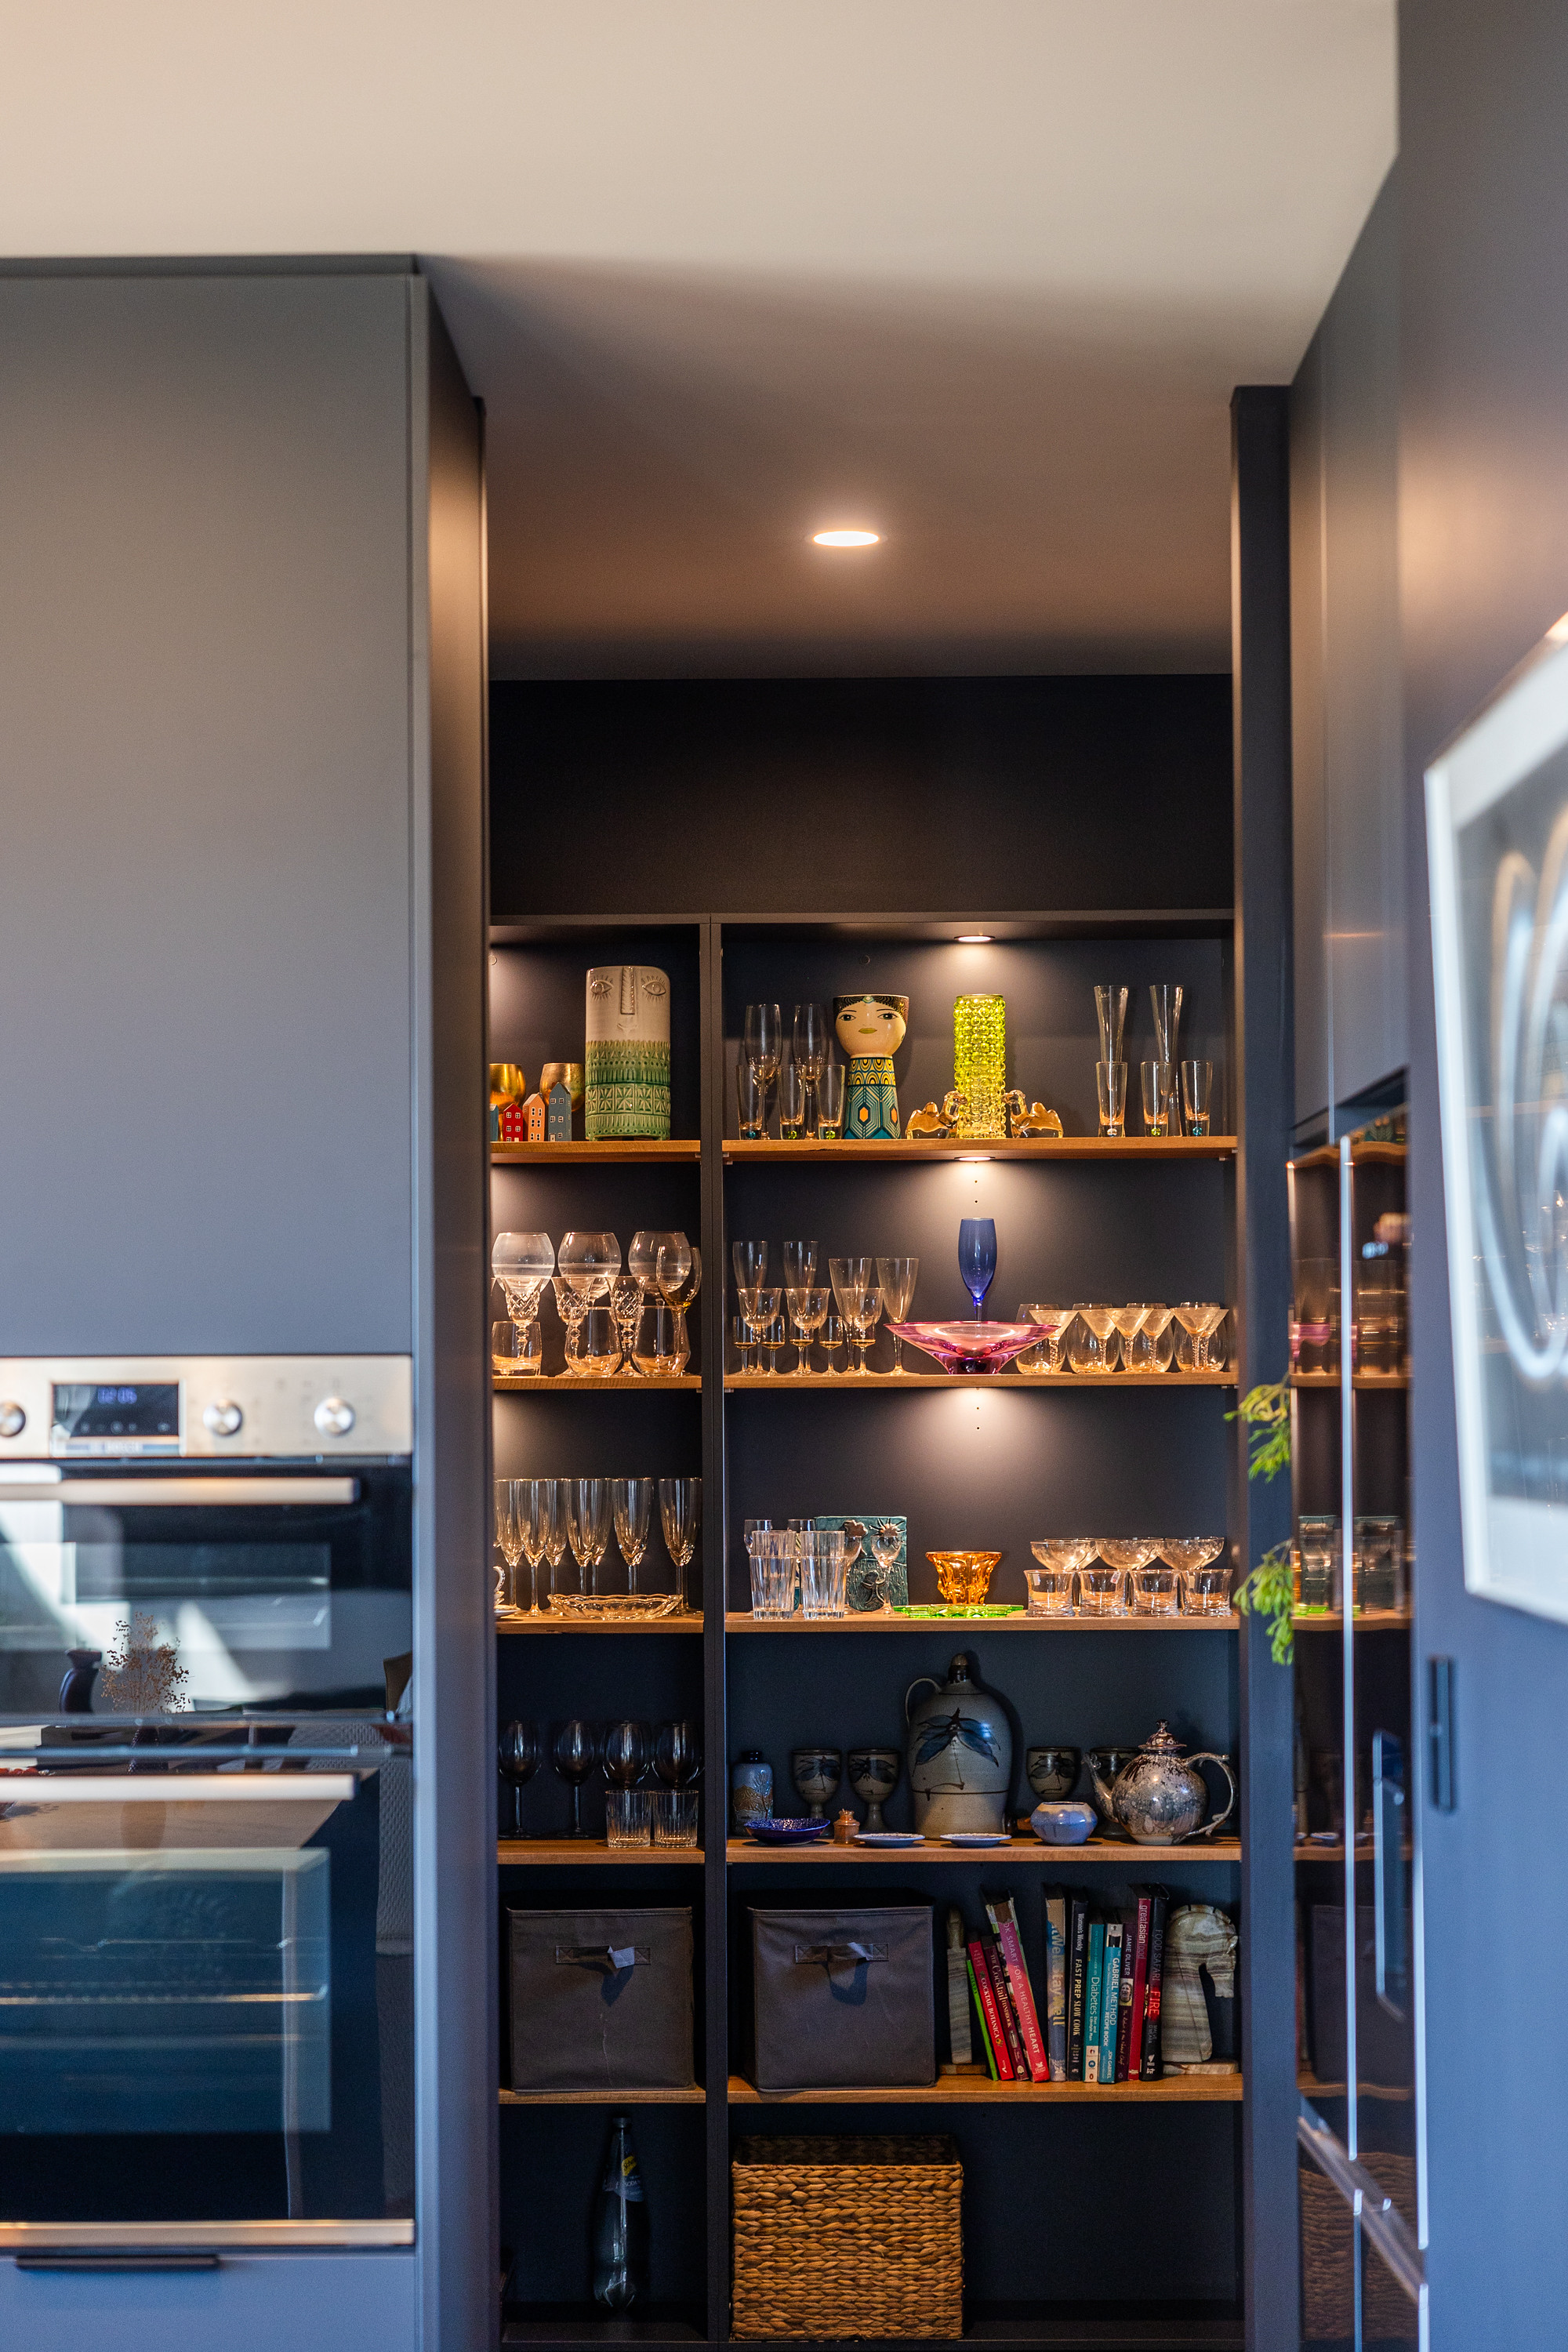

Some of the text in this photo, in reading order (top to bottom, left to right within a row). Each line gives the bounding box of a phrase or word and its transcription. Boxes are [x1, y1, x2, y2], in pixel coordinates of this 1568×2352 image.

[1003, 1923, 1012, 1933] OK
[1006, 1936, 1018, 1962] SMART
[1013, 1965, 1022, 1980] FOR
[1149, 1929, 1163, 2016] FOOD SAFARI FIRE
[981, 1978, 1000, 2038] COCKTAIL BOTANICA
[1020, 1991, 1033, 2025] HEALTHY
[1090, 1977, 1100, 2014] Diabetes
[1028, 2027, 1040, 2054] HEART
